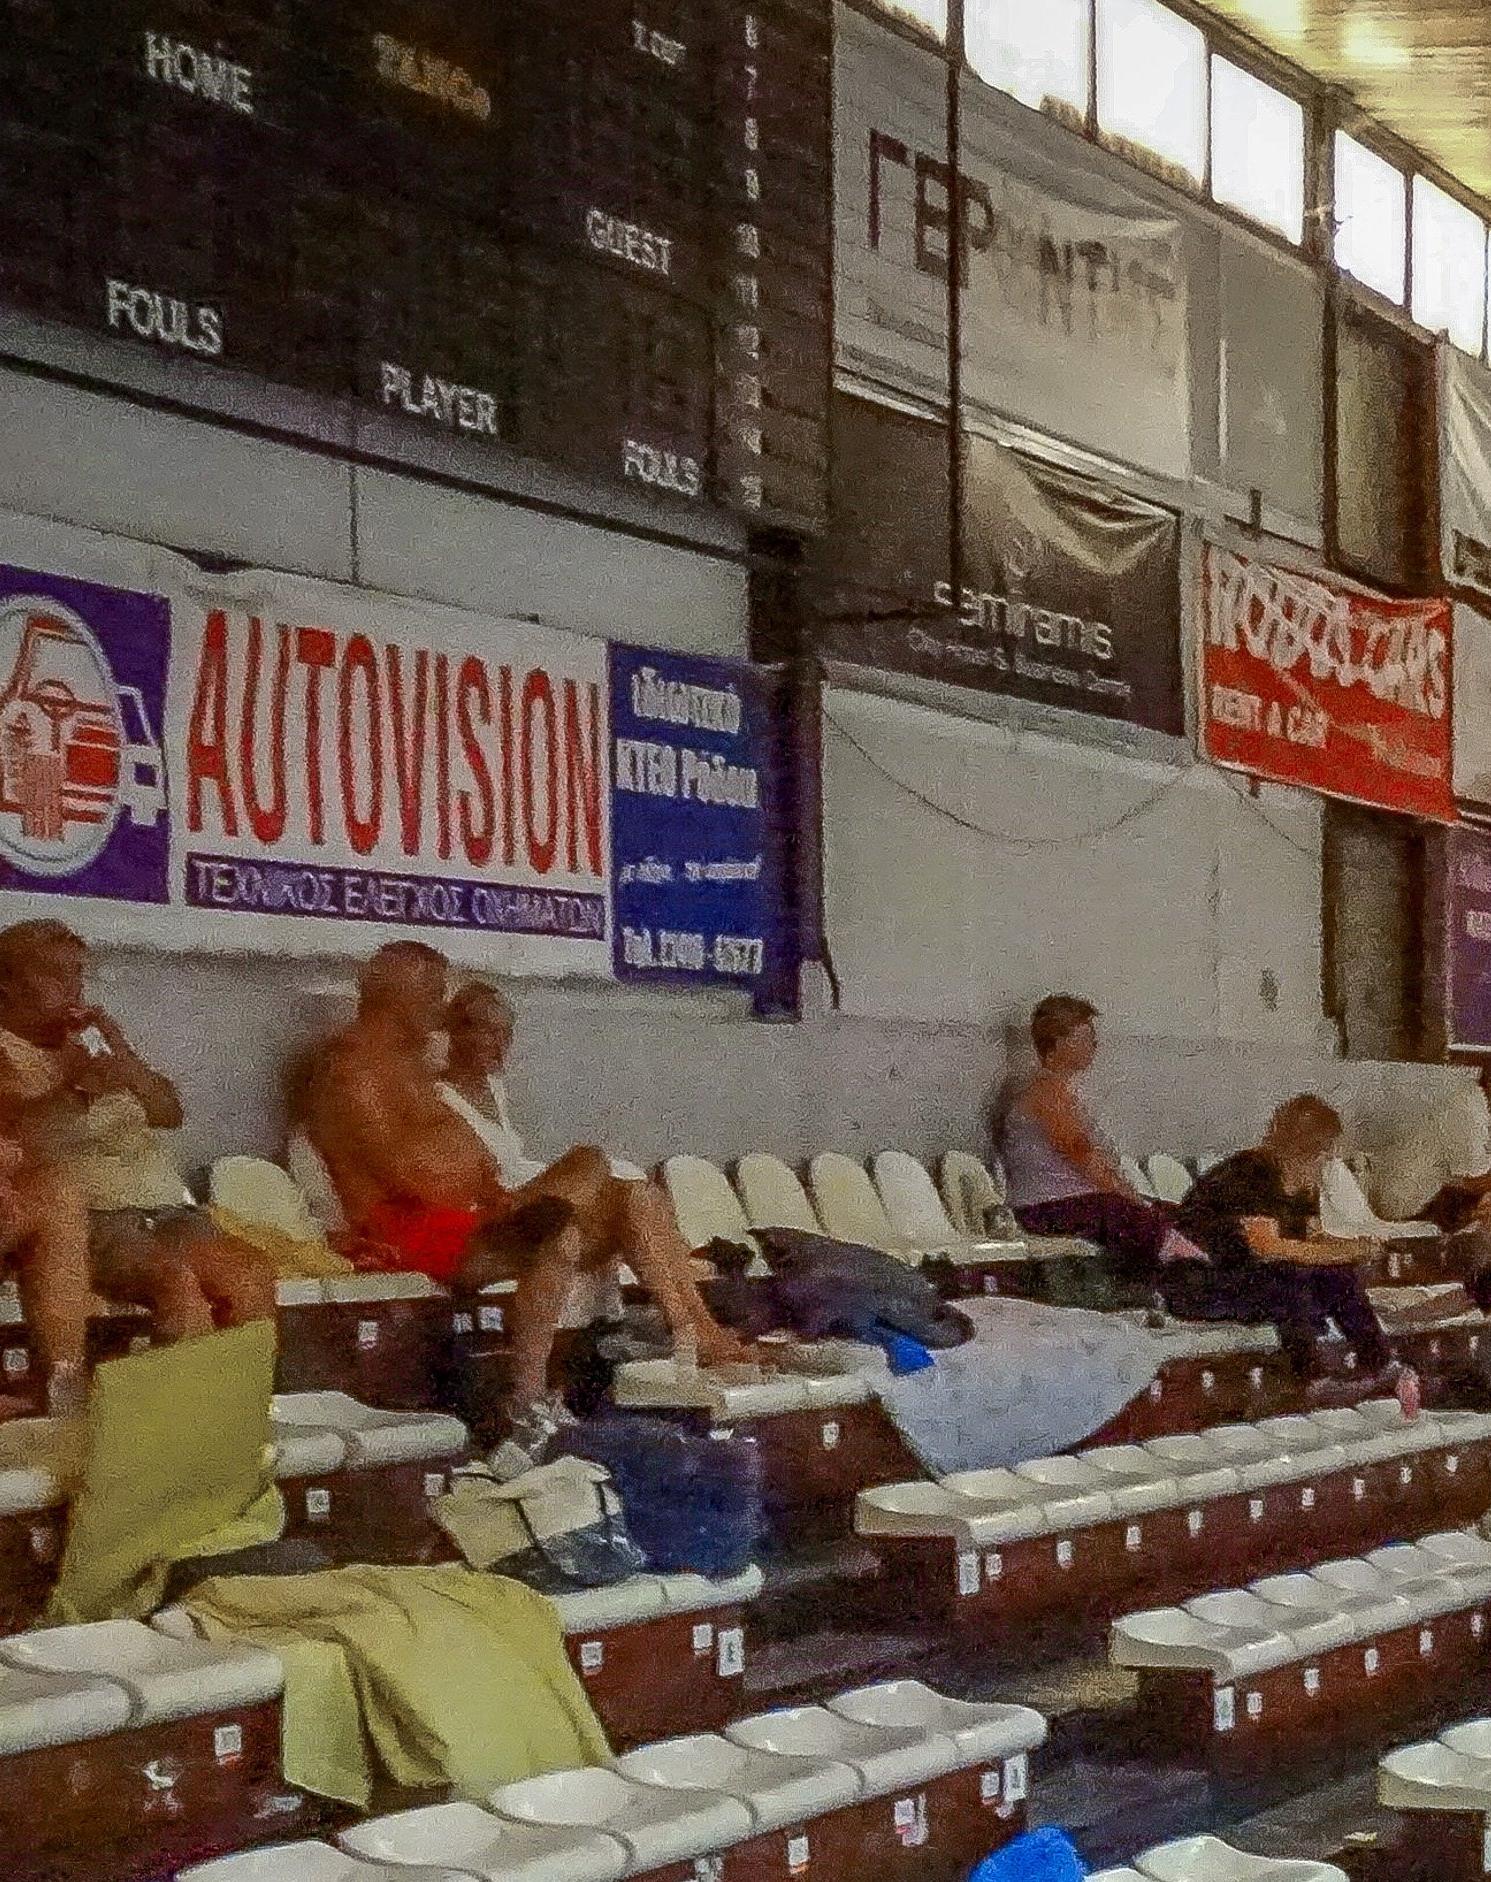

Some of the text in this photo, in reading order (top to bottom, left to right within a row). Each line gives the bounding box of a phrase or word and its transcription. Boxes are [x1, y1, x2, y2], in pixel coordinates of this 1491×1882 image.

[142, 30, 255, 117] HOME
[585, 208, 674, 276] GUEST
[107, 278, 225, 357] FOULS
[381, 360, 499, 436] PLAYER
[623, 439, 701, 498] FOULS
[186, 606, 604, 880] AUTOVISION
